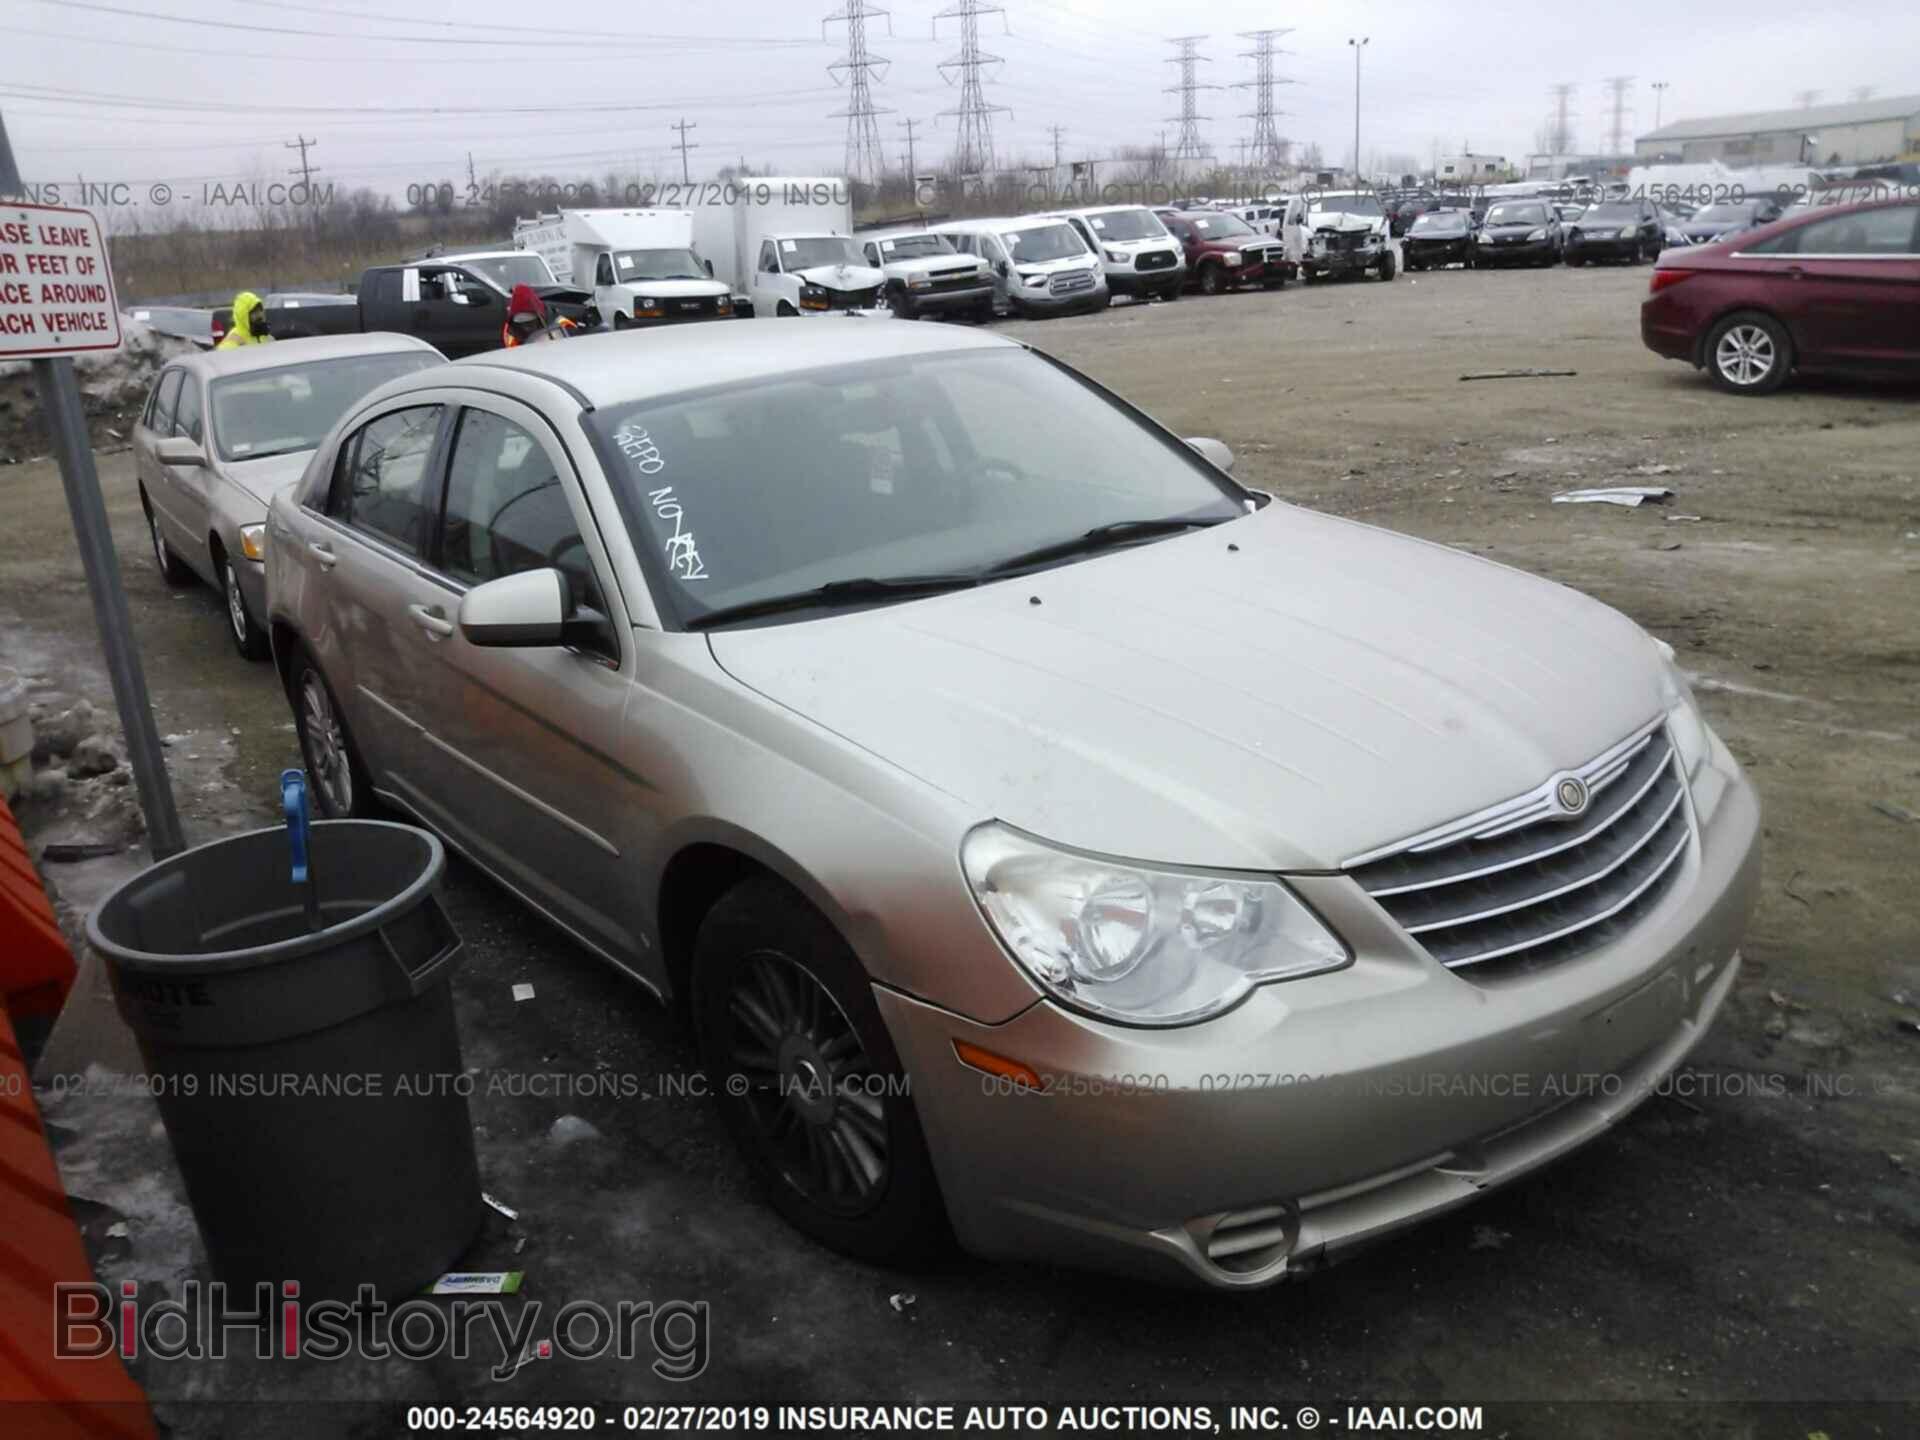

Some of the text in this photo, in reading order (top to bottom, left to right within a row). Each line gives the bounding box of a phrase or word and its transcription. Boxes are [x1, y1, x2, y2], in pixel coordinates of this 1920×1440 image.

[38, 224, 91, 247] LEAVE
[25, 254, 68, 274] FEET
[75, 256, 95, 275] OF
[41, 283, 106, 303] AROUND
[42, 311, 108, 332] VEHICLE
